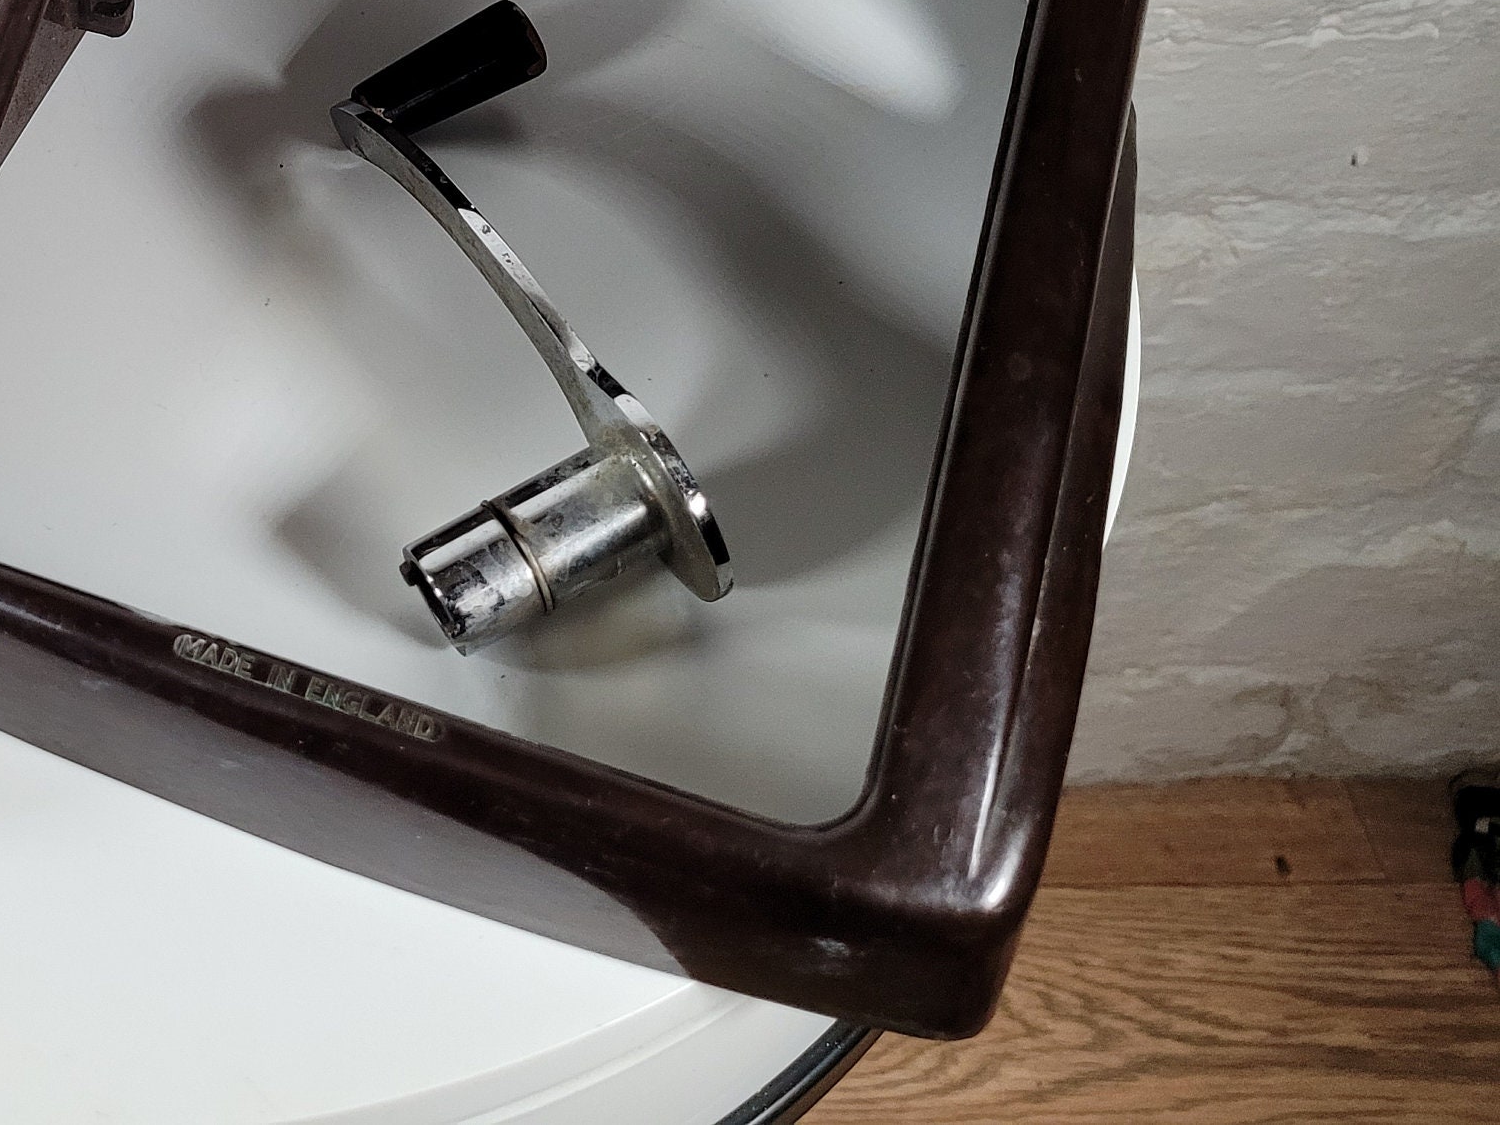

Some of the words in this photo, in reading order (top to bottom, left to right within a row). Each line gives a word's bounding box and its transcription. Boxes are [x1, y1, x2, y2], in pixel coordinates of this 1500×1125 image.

[177, 634, 255, 679] MADE
[266, 663, 296, 694] IN
[305, 676, 441, 742] ENGLAND
